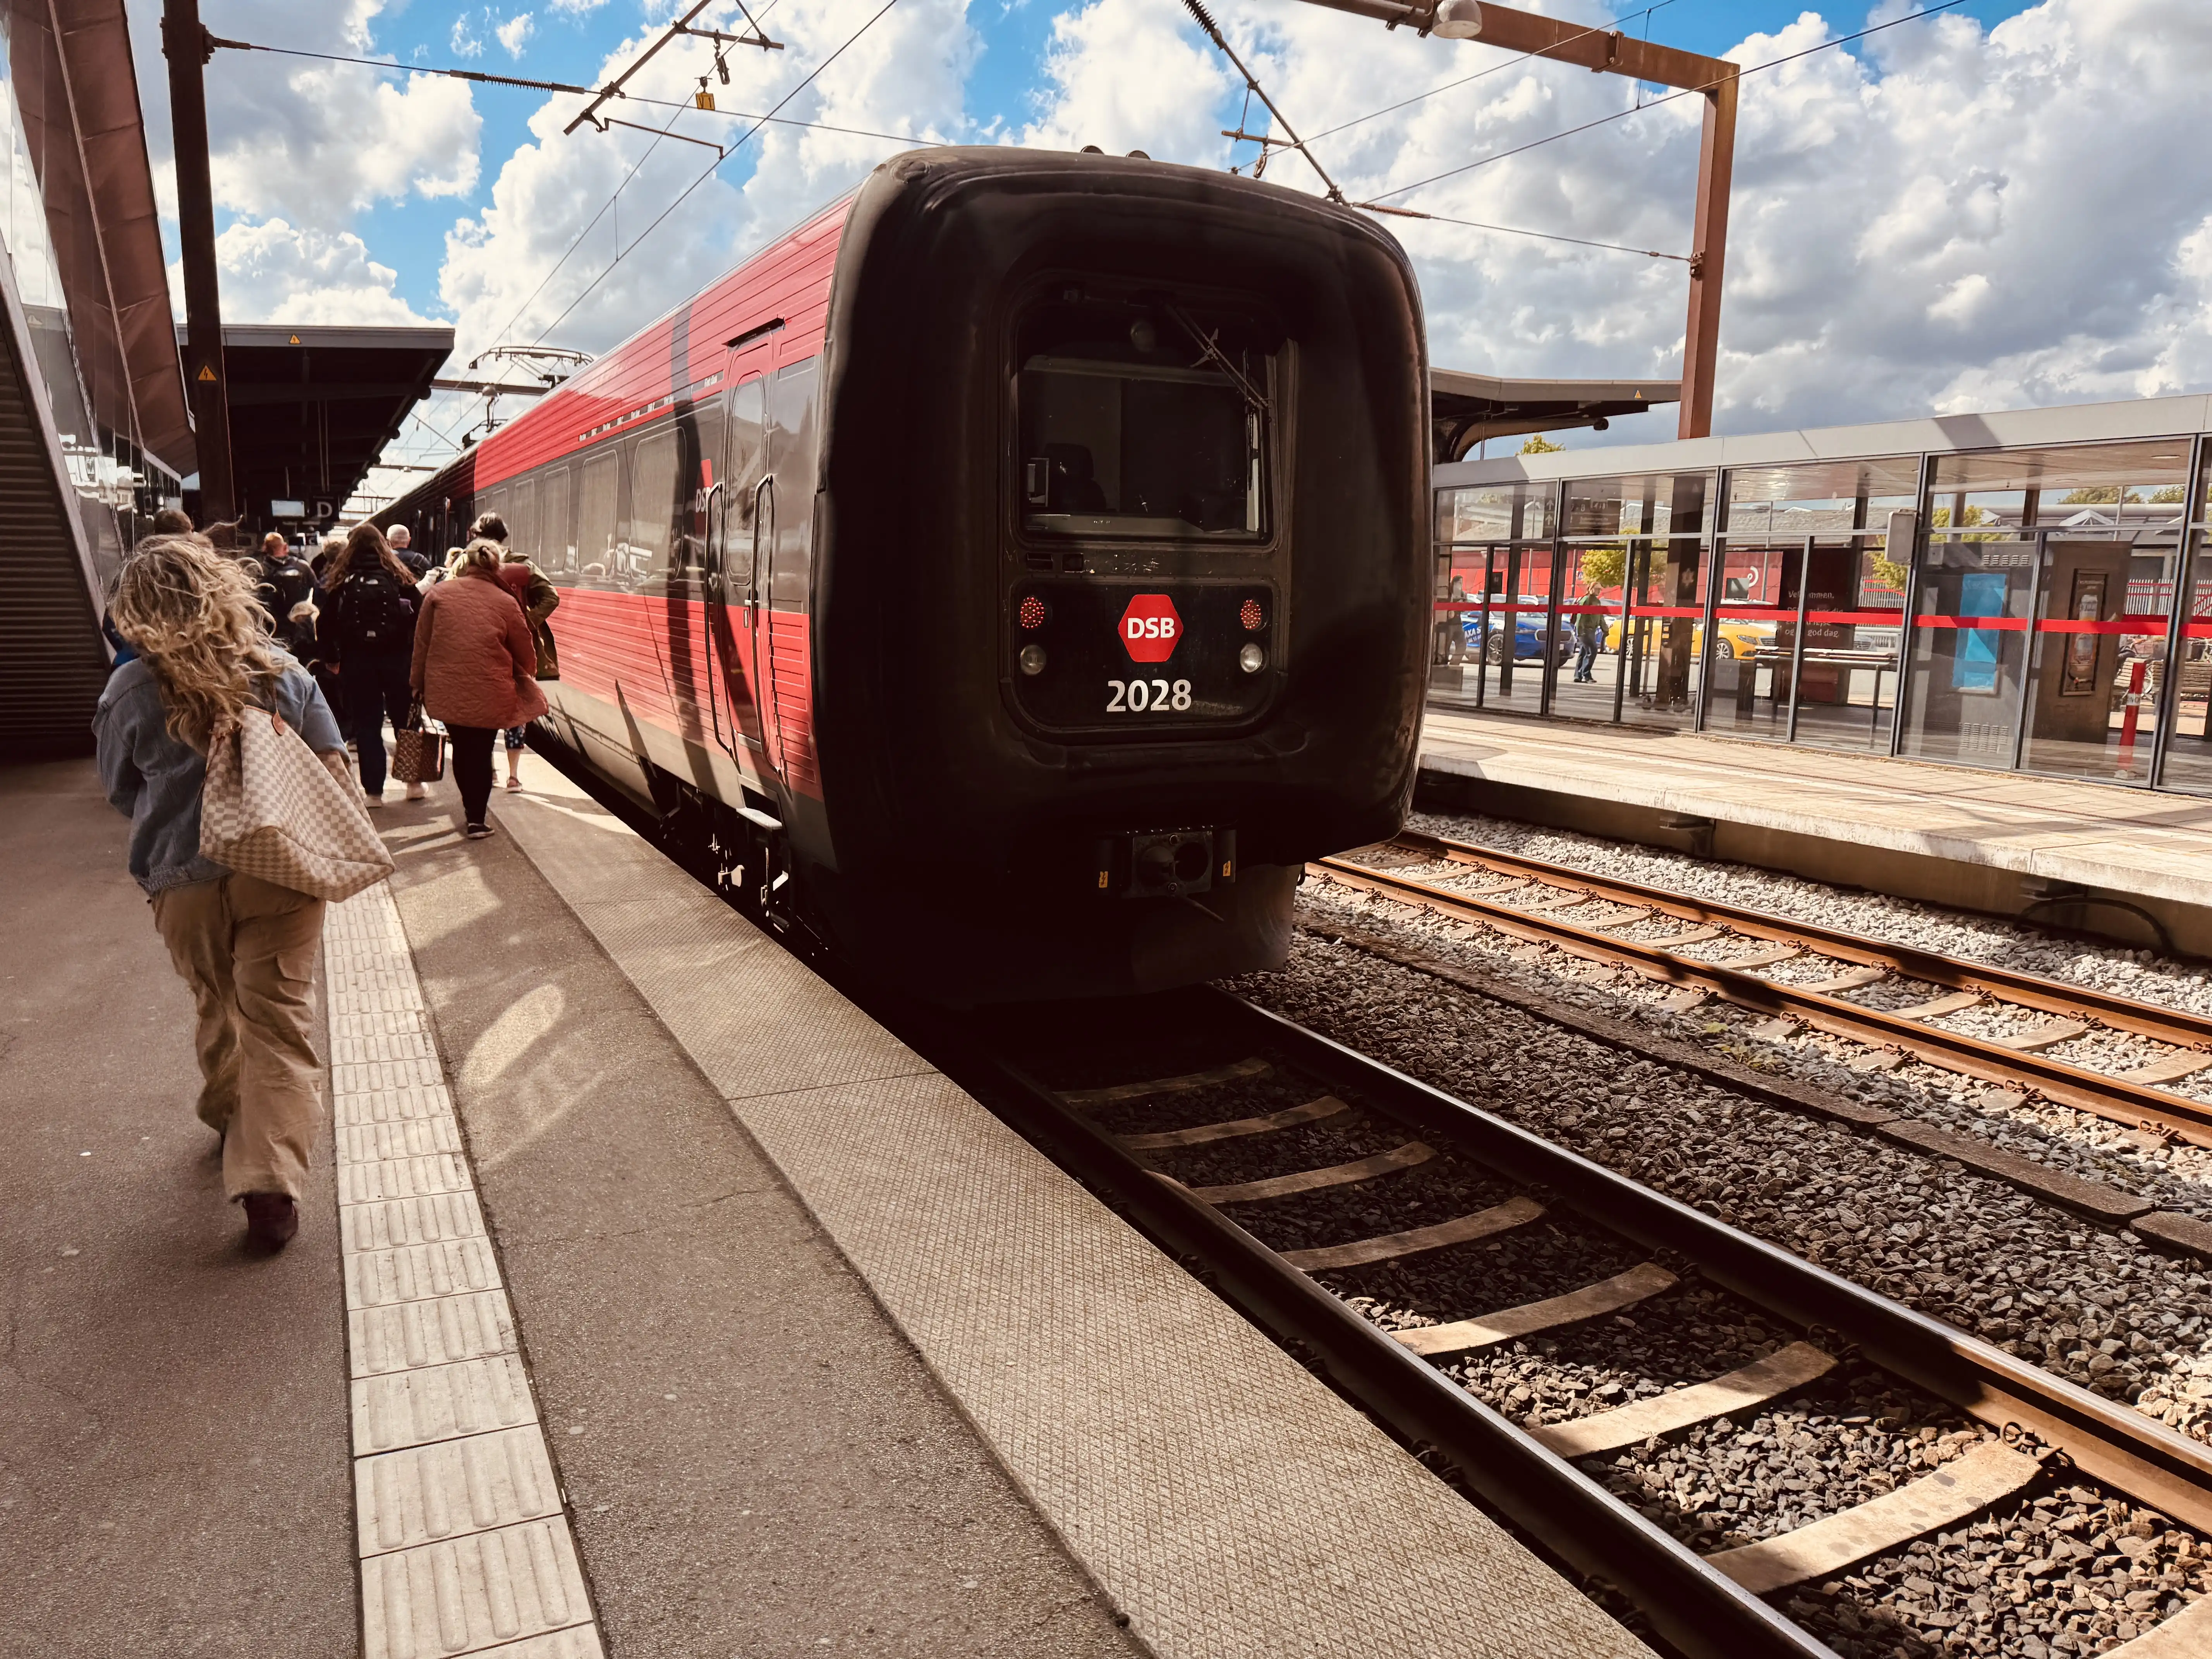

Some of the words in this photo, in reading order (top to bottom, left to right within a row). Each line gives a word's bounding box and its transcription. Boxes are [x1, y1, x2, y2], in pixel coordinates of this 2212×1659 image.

[317, 501, 333, 518] D
[1127, 617, 1175, 639] DSB
[1106, 679, 1192, 713] 2028
